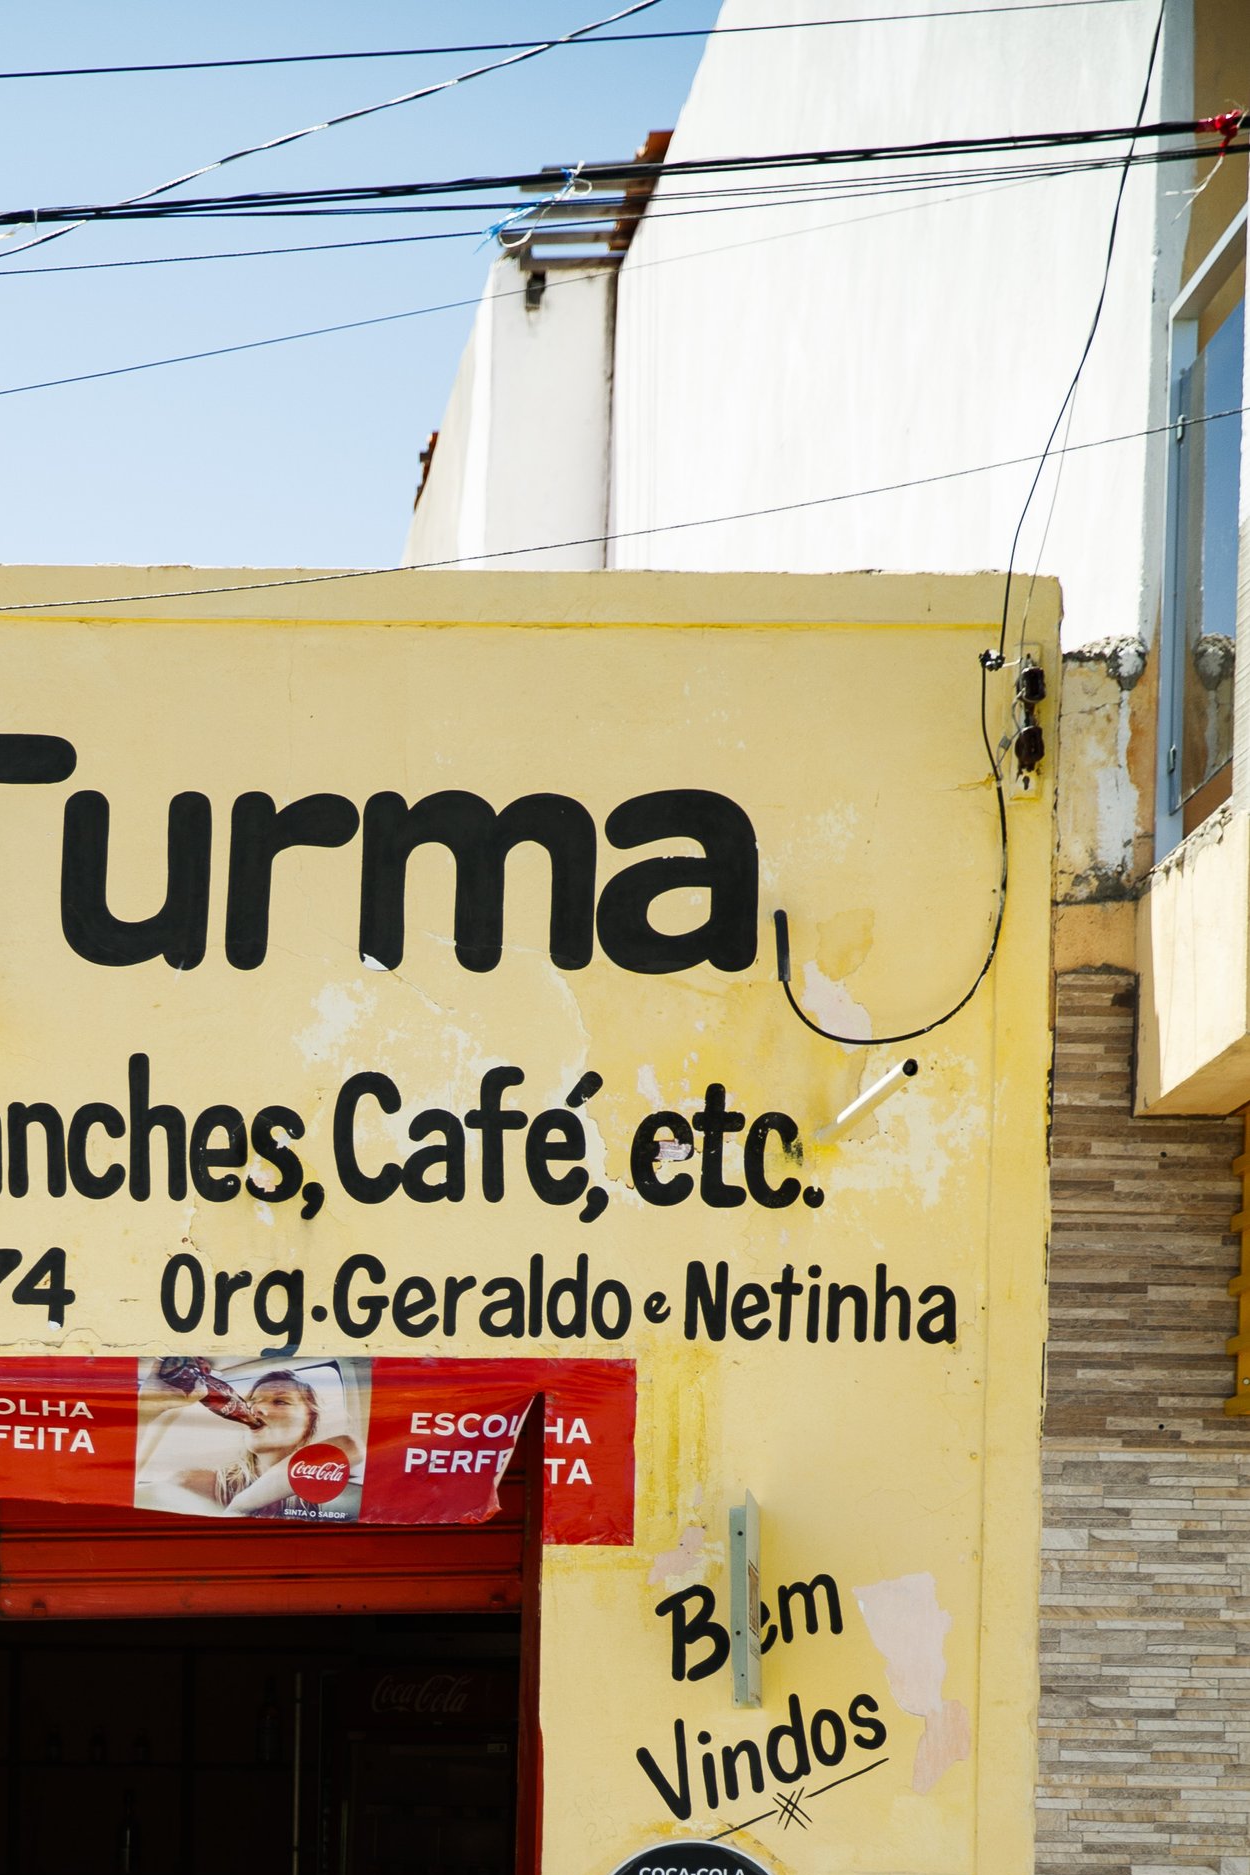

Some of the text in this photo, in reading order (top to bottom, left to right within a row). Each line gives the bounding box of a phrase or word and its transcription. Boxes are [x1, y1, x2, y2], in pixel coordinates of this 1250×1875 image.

[334, 1066, 609, 1223] Café,
[630, 1083, 823, 1209] etc.
[645, 1290, 670, 1325] e
[684, 1261, 957, 1345] Netinha
[284, 1508, 307, 1517] SINTA
[290, 1460, 347, 1482] Coca-Cola
[636, 1693, 887, 1820] Vindos
